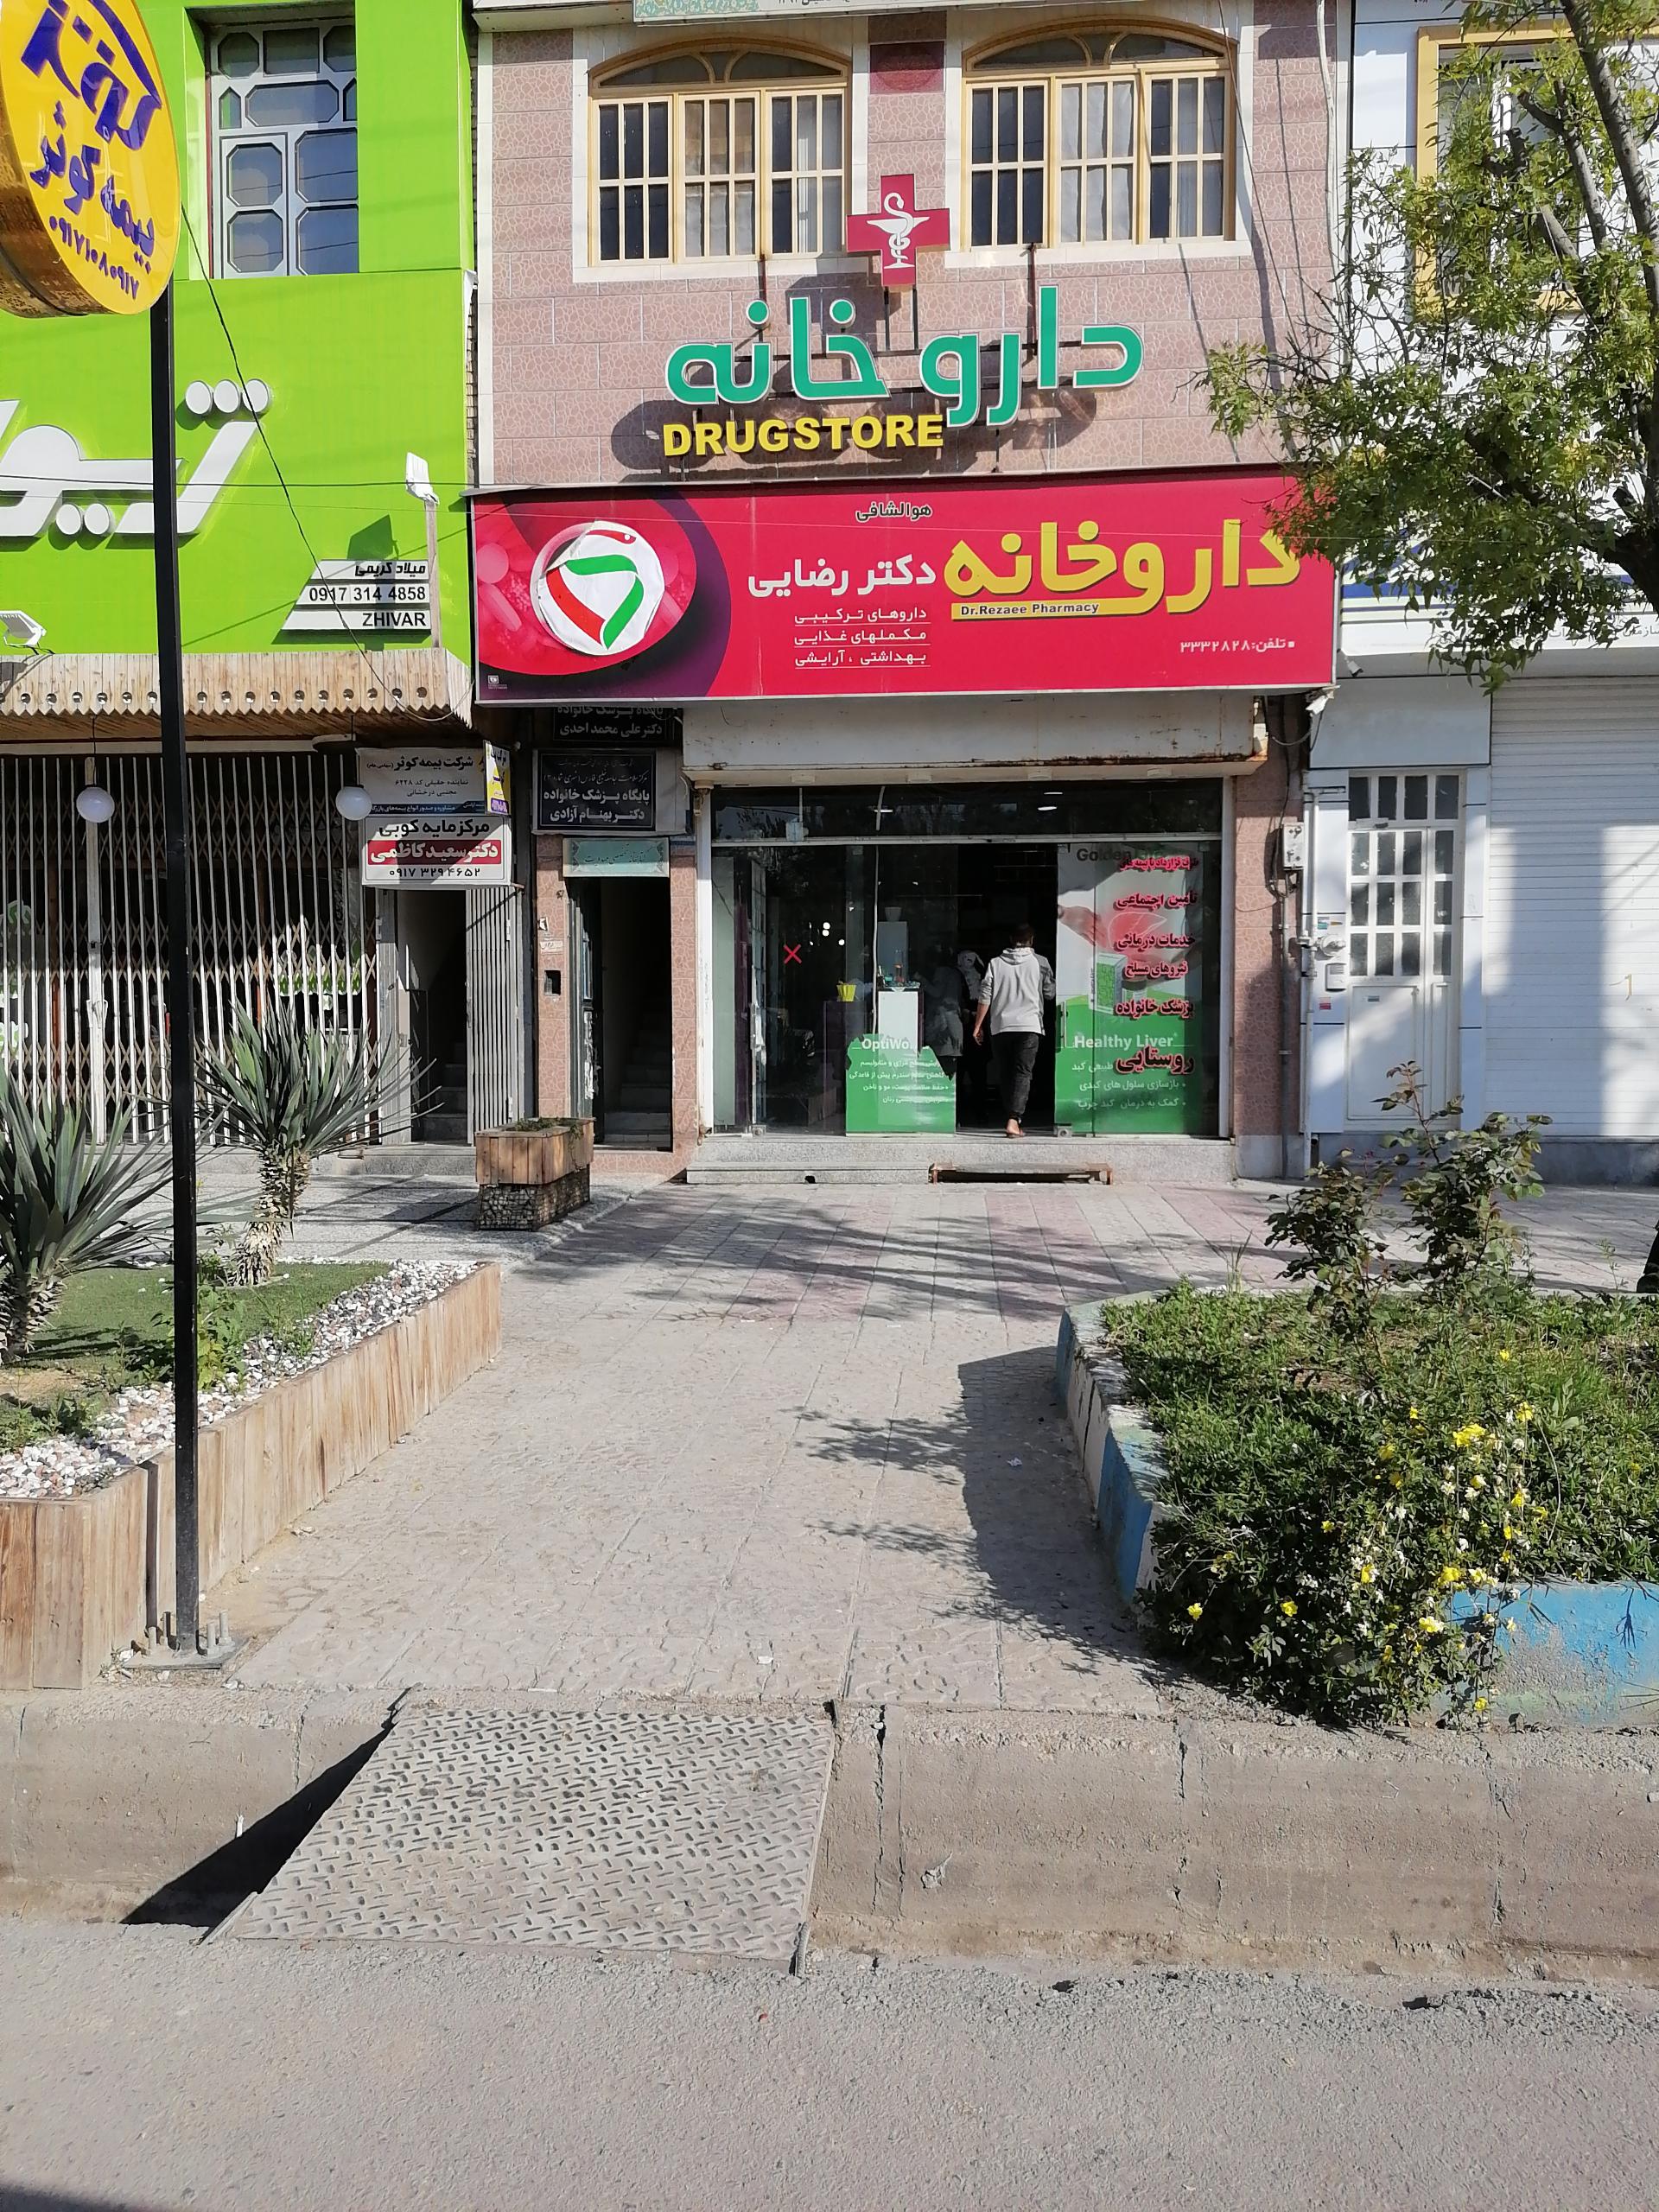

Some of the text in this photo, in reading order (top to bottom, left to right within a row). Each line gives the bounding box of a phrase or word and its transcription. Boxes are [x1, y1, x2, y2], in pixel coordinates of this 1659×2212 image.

[29, 101, 155, 274] بیمه کوثر
[664, 284, 1144, 428] داروخانه
[663, 414, 944, 457] DRUGSTORE
[355, 562, 426, 577] میلاد کریمی
[748, 554, 937, 597] دکتر رضایی
[309, 587, 426, 601] 0917 314 4858
[794, 607, 927, 624] داروهای ترکیبی
[961, 601, 1100, 616] Dr.Rezaee Pharmacy
[362, 612, 427, 626] ZHIVAR
[794, 628, 926, 646] مکملهای غذایی
[795, 650, 846, 667] آرایشی
[860, 651, 926, 665] بهداشتی
[591, 725, 618, 734] محمد
[620, 722, 640, 737] علی
[641, 724, 662, 737] دکتر
[394, 754, 419, 771] کوثر
[419, 758, 442, 771] بیمه
[443, 756, 474, 771] شرکت
[543, 788, 650, 804] پایگاه پزشک خانواده
[550, 805, 645, 823] دکتر بهنام آزادی
[378, 819, 490, 837] مرکز مایه کوبی
[371, 842, 499, 863] دکتر سعید کاظمی
[390, 868, 416, 877] ۰۹۱۷
[1116, 893, 1165, 910] اجتماعی
[1117, 932, 1196, 950] خدمات درمانی
[1116, 998, 1159, 1018] خانواده
[1074, 1034, 1173, 1051] Healthy Liver
[1071, 1061, 1086, 1071] کبد
[1116, 1045, 1196, 1074] روستایی
[1103, 1079, 1122, 1090] های
[1122, 1079, 1145, 1090] سلول
[1147, 1079, 1179, 1090] بازسازی
[1157, 1097, 1179, 1107] کمک
